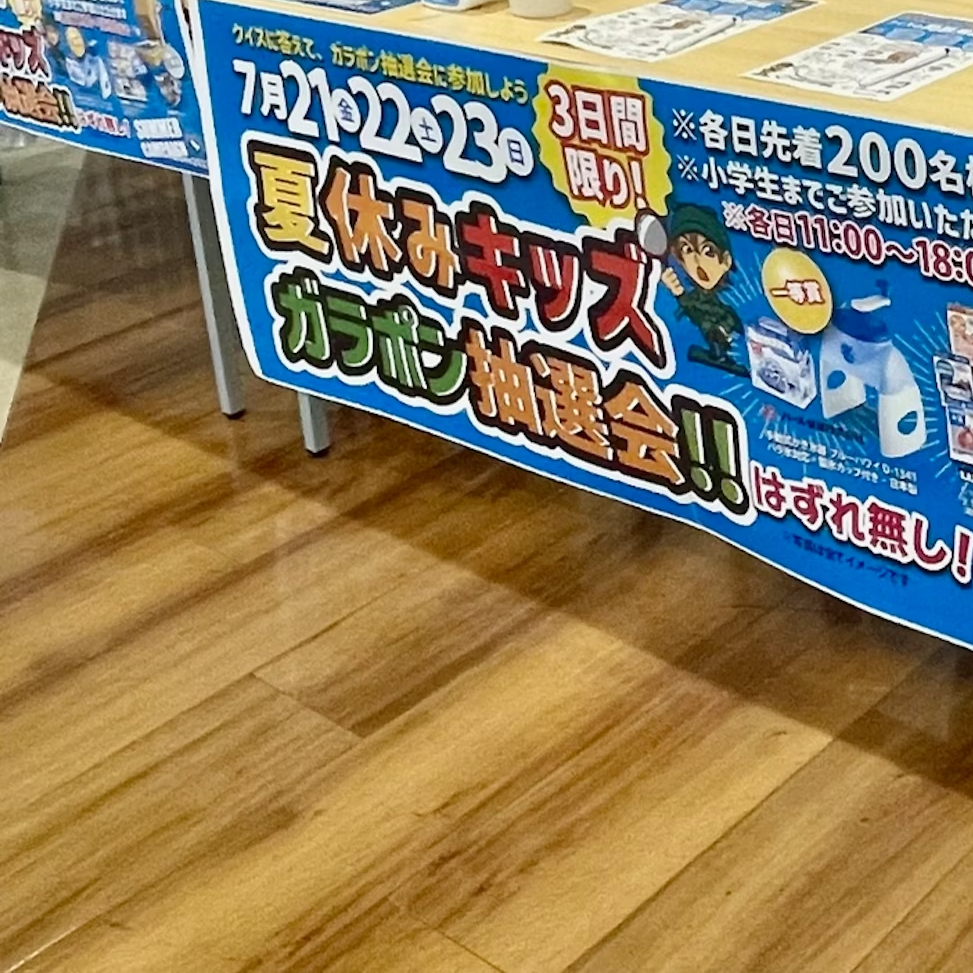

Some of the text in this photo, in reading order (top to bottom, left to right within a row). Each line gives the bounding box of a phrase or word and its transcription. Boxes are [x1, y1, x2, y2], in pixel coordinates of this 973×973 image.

[545, 78, 648, 153] 3日間
[563, 145, 646, 209] 限り!
[247, 139, 670, 370] 夏休みキッズ
